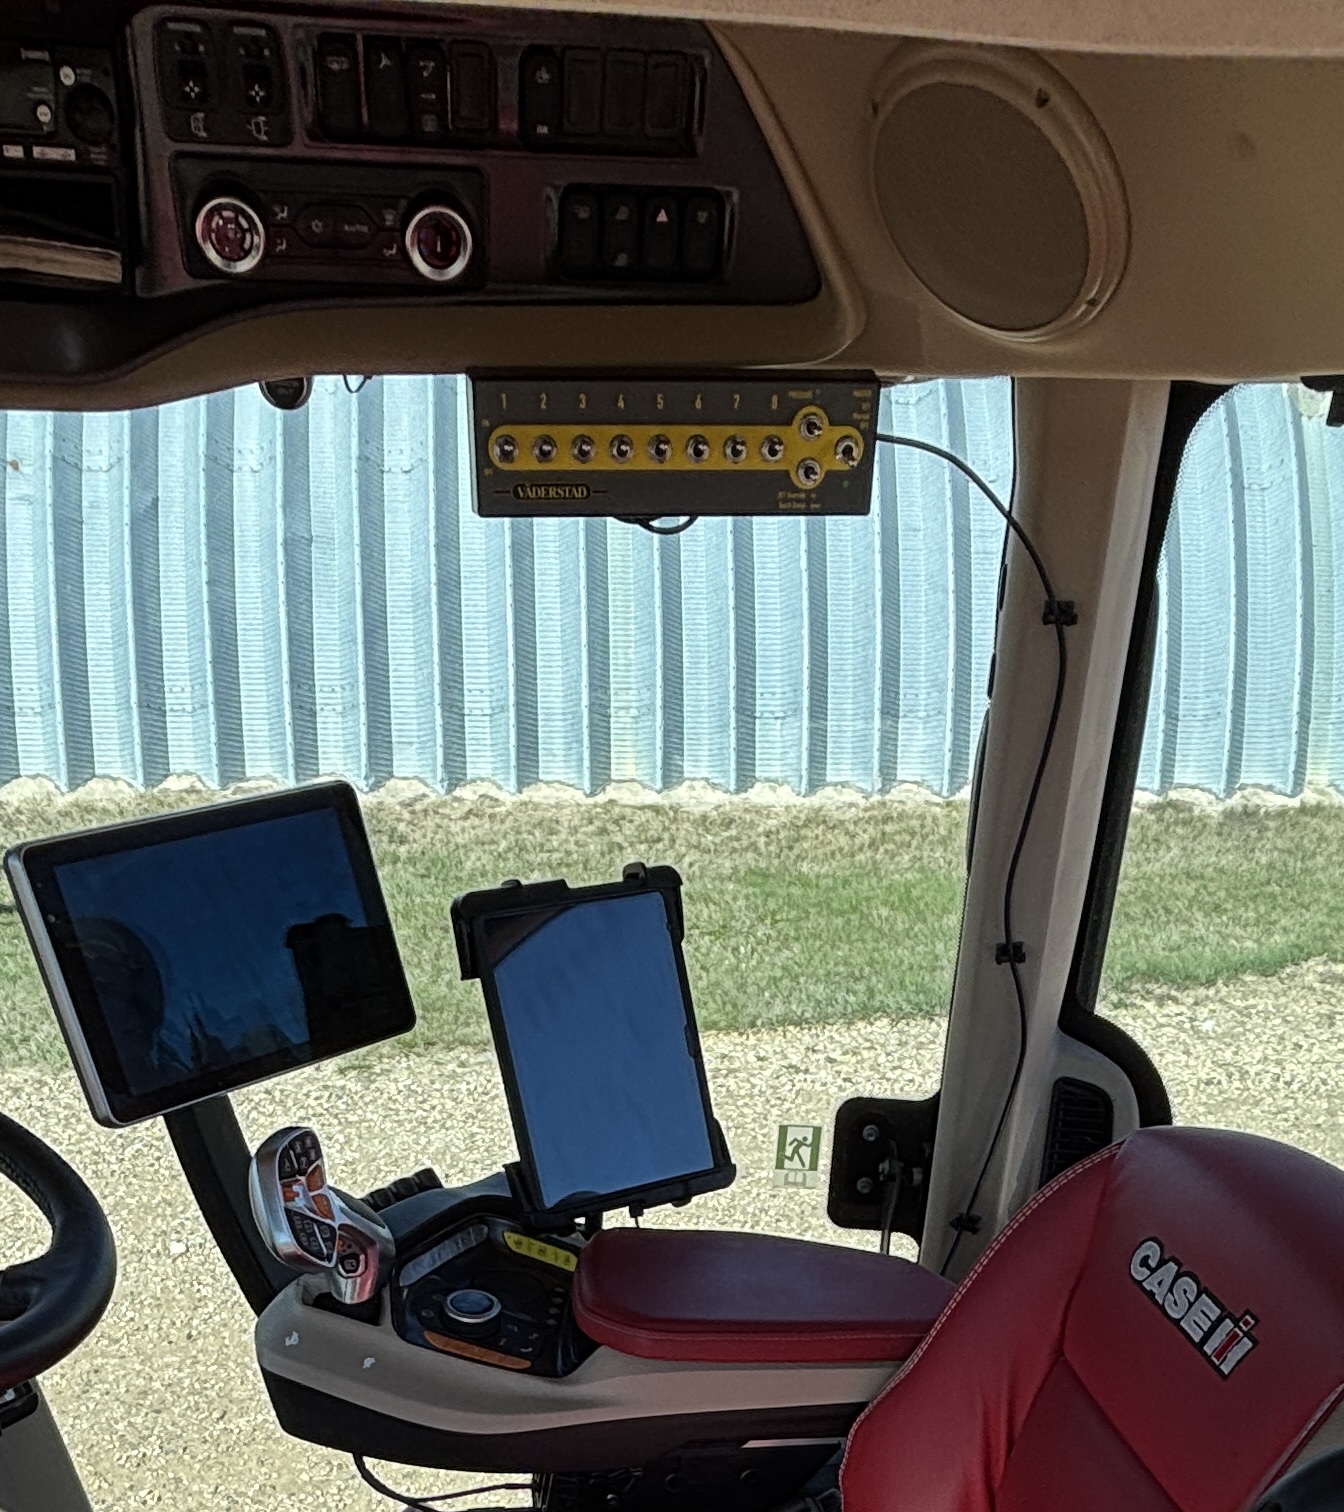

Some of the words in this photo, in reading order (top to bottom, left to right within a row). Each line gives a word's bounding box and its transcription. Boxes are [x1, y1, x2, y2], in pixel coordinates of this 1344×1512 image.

[500, 393, 507, 410] 1
[539, 393, 548, 410] 2
[579, 393, 587, 410] 3
[617, 394, 625, 410] 4
[656, 394, 664, 410] 5
[694, 394, 702, 410] 6
[733, 394, 741, 410] 7
[1130, 1240, 1222, 1343] CASE
